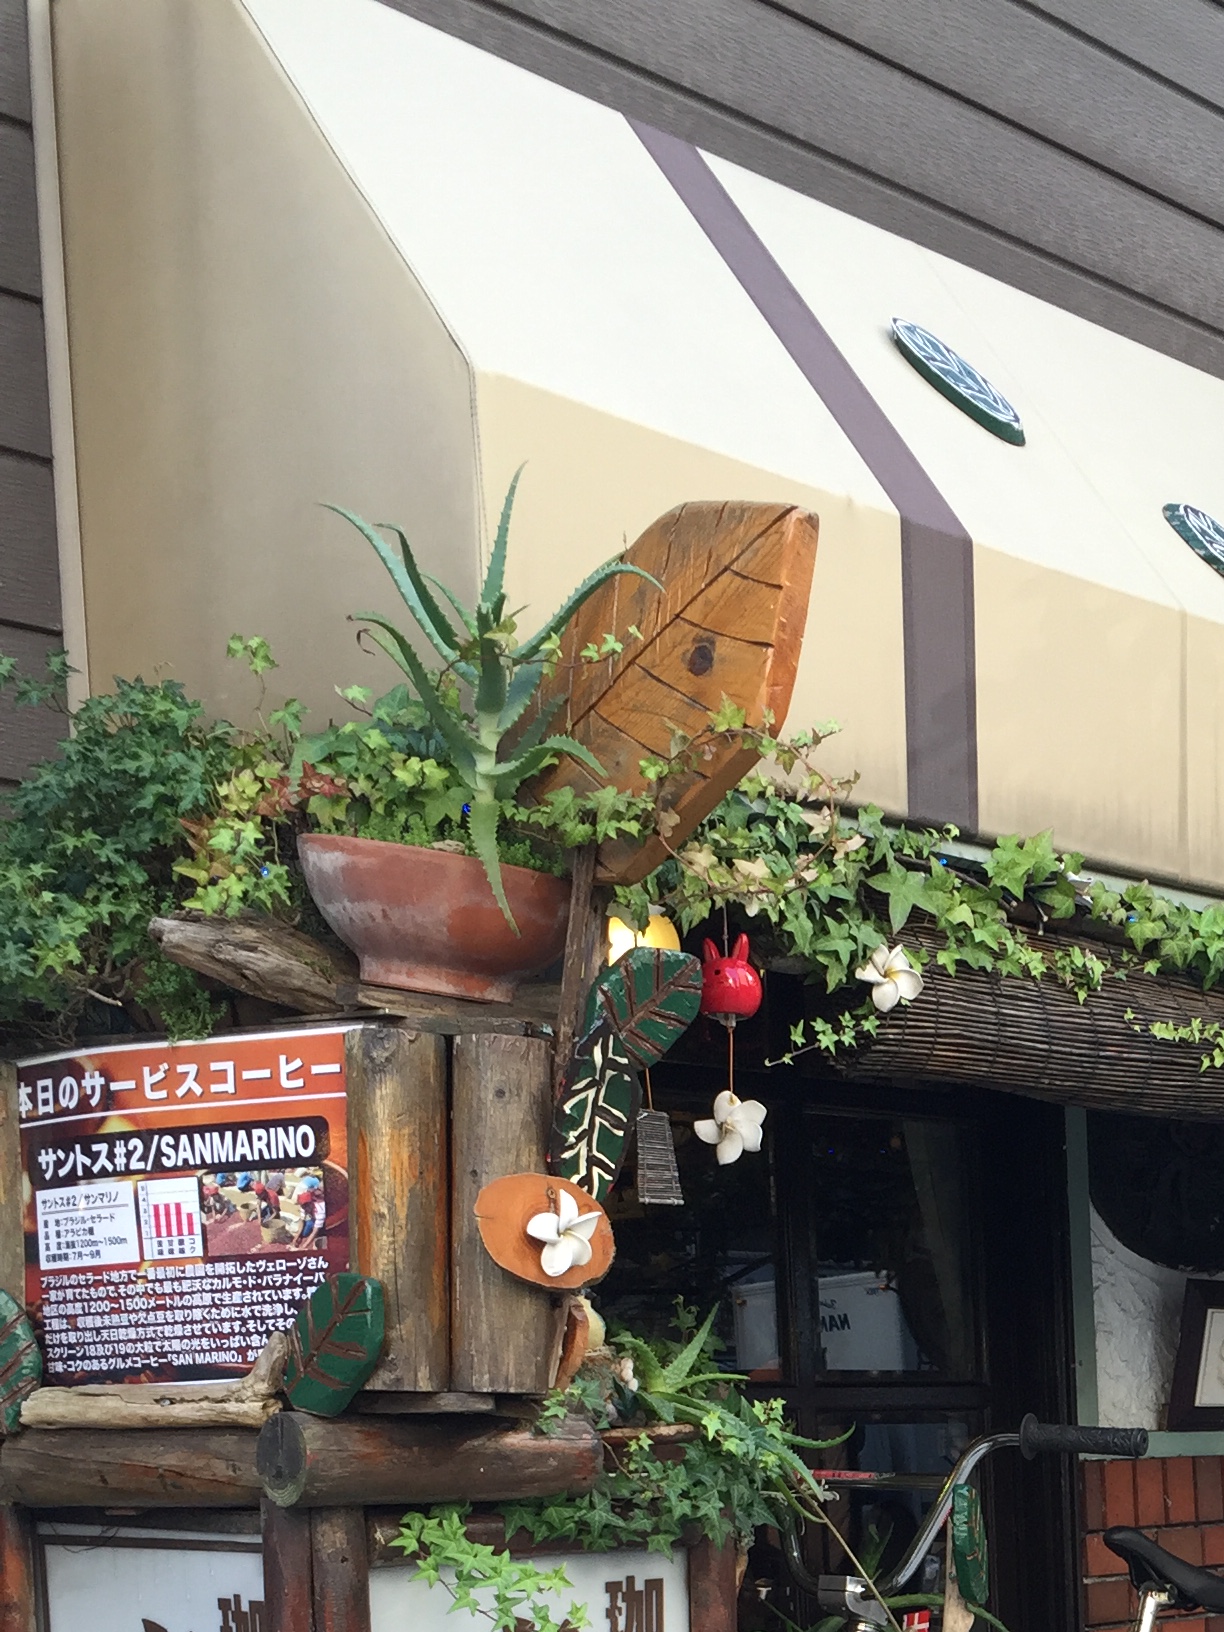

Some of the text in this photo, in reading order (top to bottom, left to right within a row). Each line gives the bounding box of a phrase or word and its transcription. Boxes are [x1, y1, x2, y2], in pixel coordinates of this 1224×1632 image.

[19, 1054, 342, 1119] 本日のサービスコーヒー
